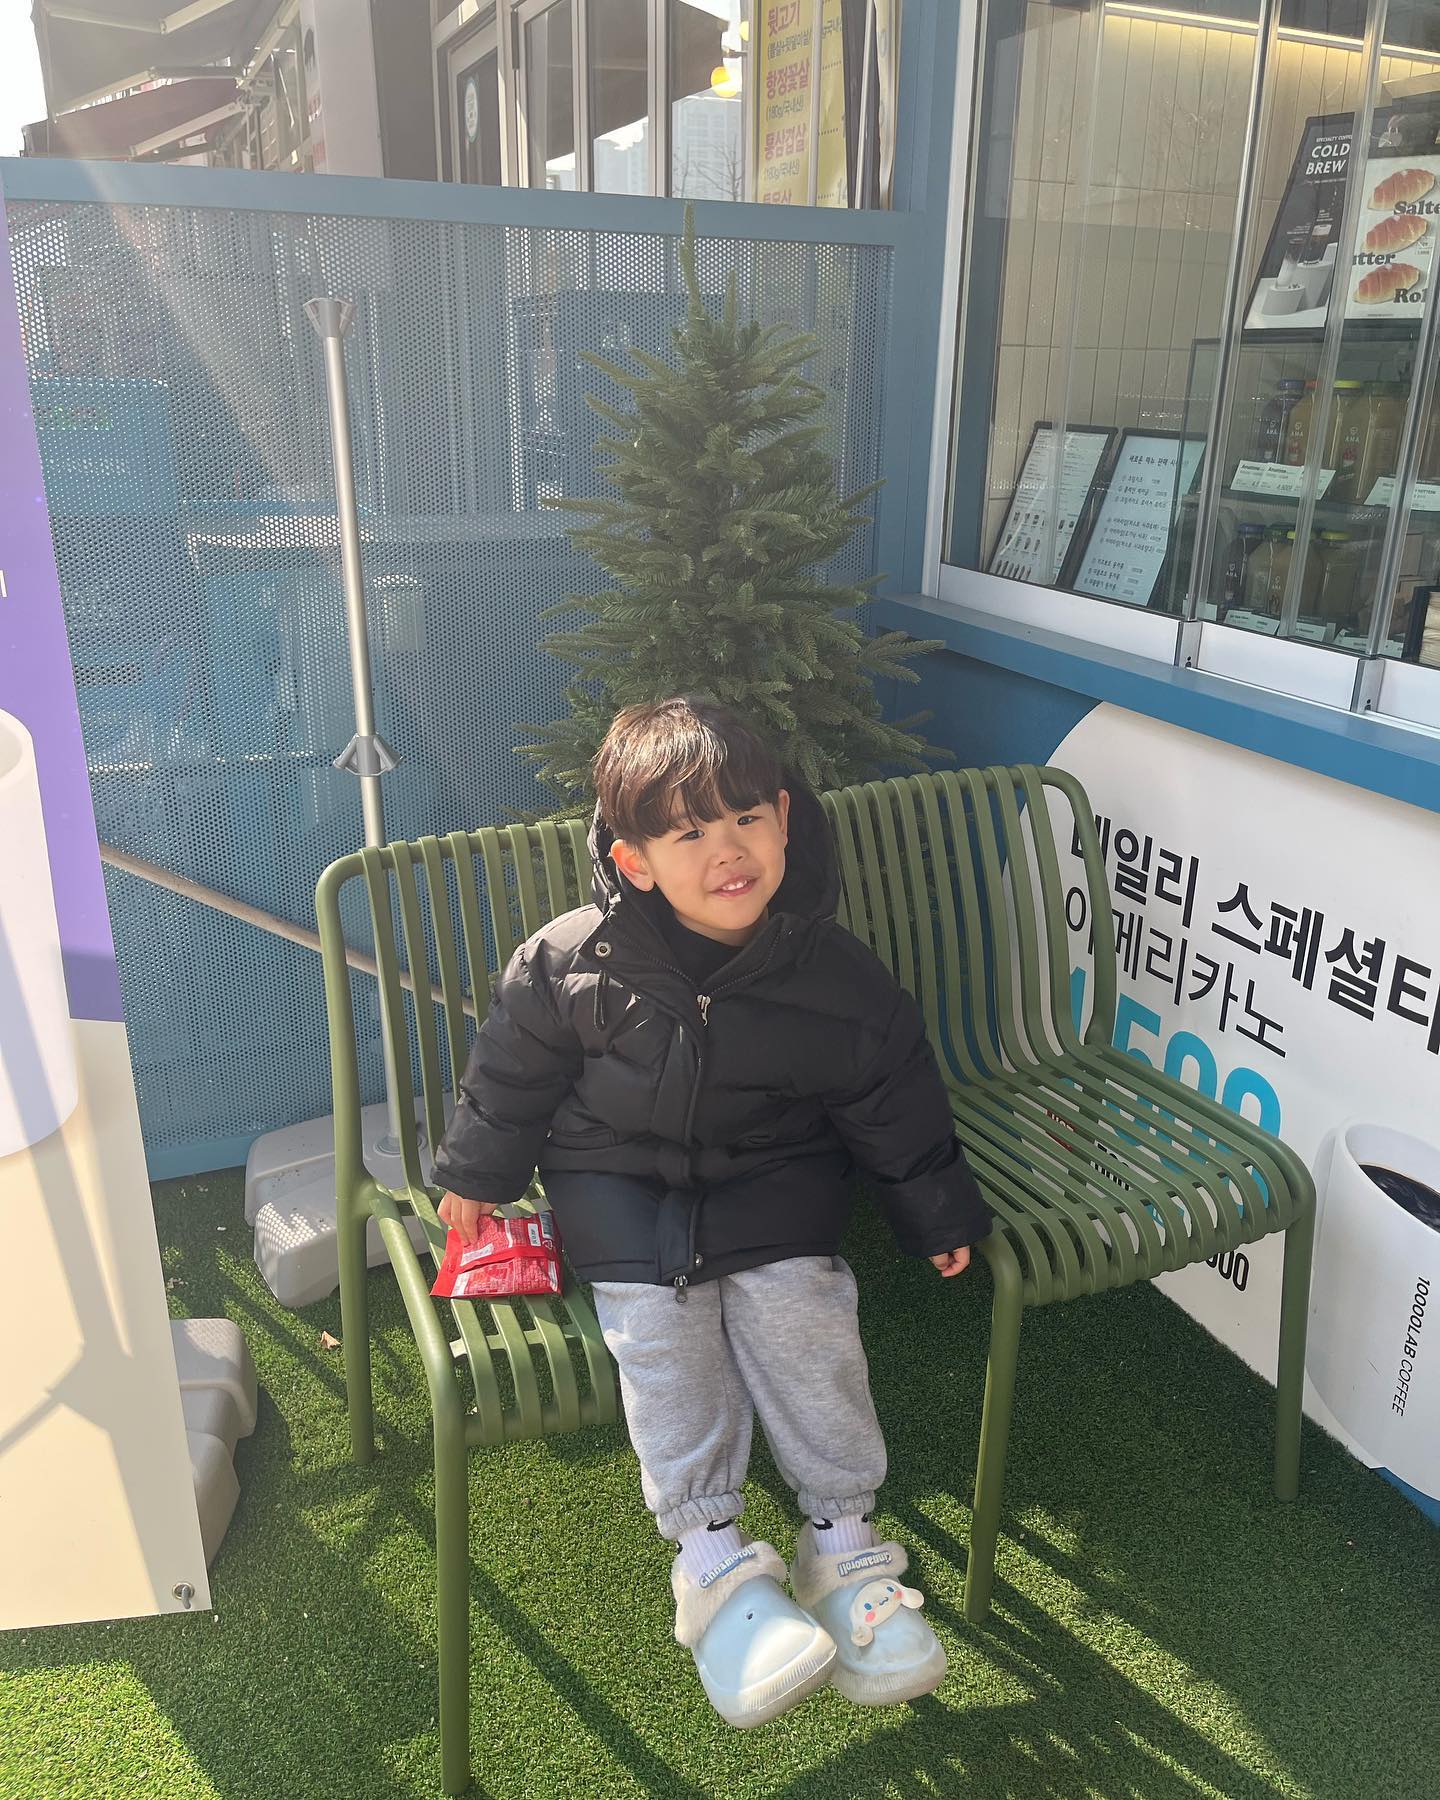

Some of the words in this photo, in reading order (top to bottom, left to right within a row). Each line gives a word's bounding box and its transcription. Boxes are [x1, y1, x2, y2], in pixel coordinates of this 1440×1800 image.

[1305, 160, 1347, 175] BREW
[1311, 143, 1351, 158] COLD
[1404, 1276, 1430, 1359] 10000LAB
[1392, 1359, 1413, 1416] COFFEE
[700, 1545, 755, 1588] Cinnamoroll
[838, 1551, 892, 1576] Cinnamoroll
